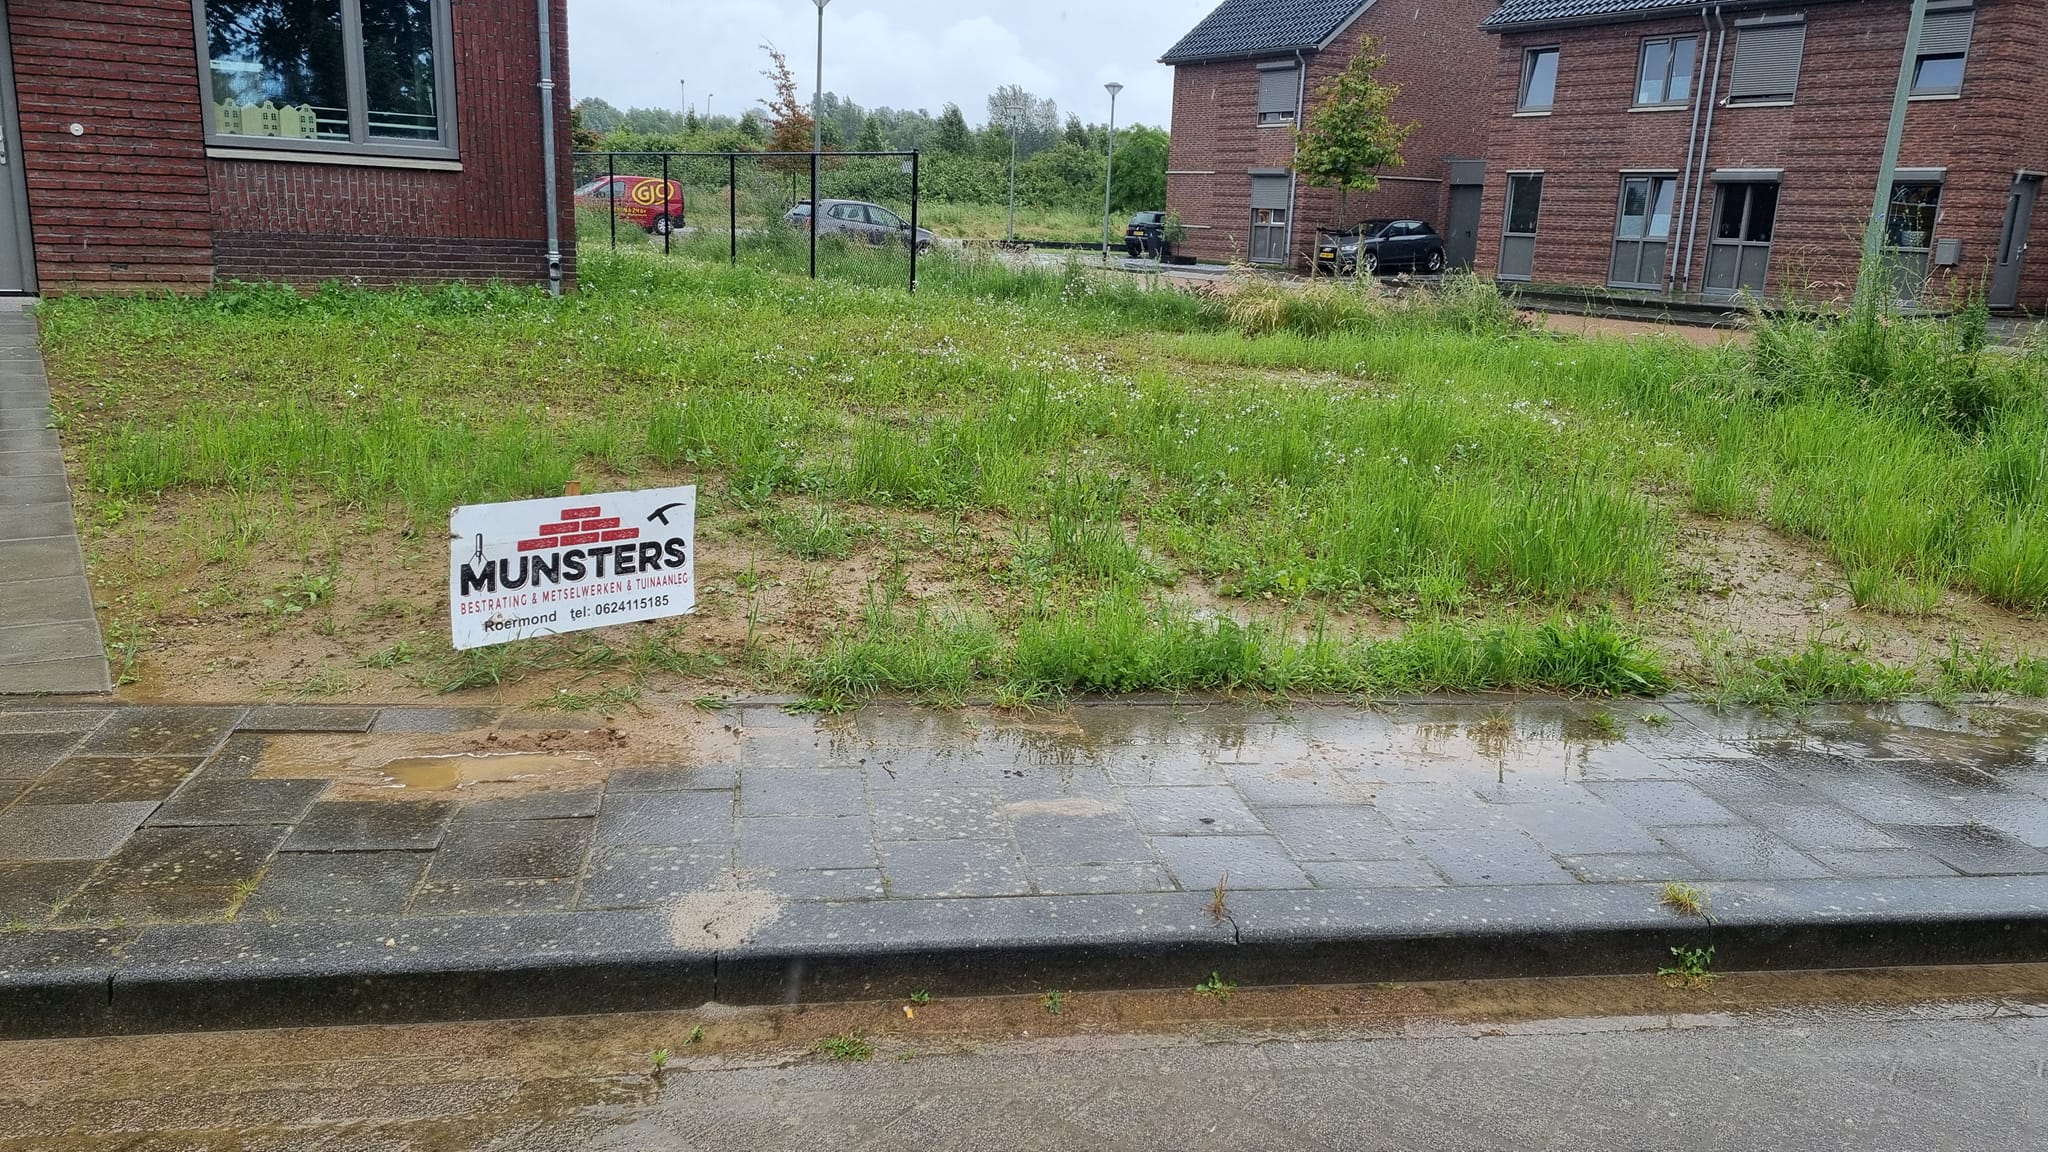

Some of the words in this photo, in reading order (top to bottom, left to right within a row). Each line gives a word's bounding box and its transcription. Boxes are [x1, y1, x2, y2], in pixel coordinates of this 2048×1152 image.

[460, 537, 687, 596] MUNSTERS
[461, 593, 527, 615] BESTRATING
[532, 593, 537, 605] &
[542, 581, 622, 601] METSELWERKEN
[627, 581, 632, 592] &
[636, 572, 688, 589] TUINAANLEG
[484, 610, 557, 633] Roermond
[570, 605, 591, 621] tel:
[595, 595, 669, 616] 0624115185
